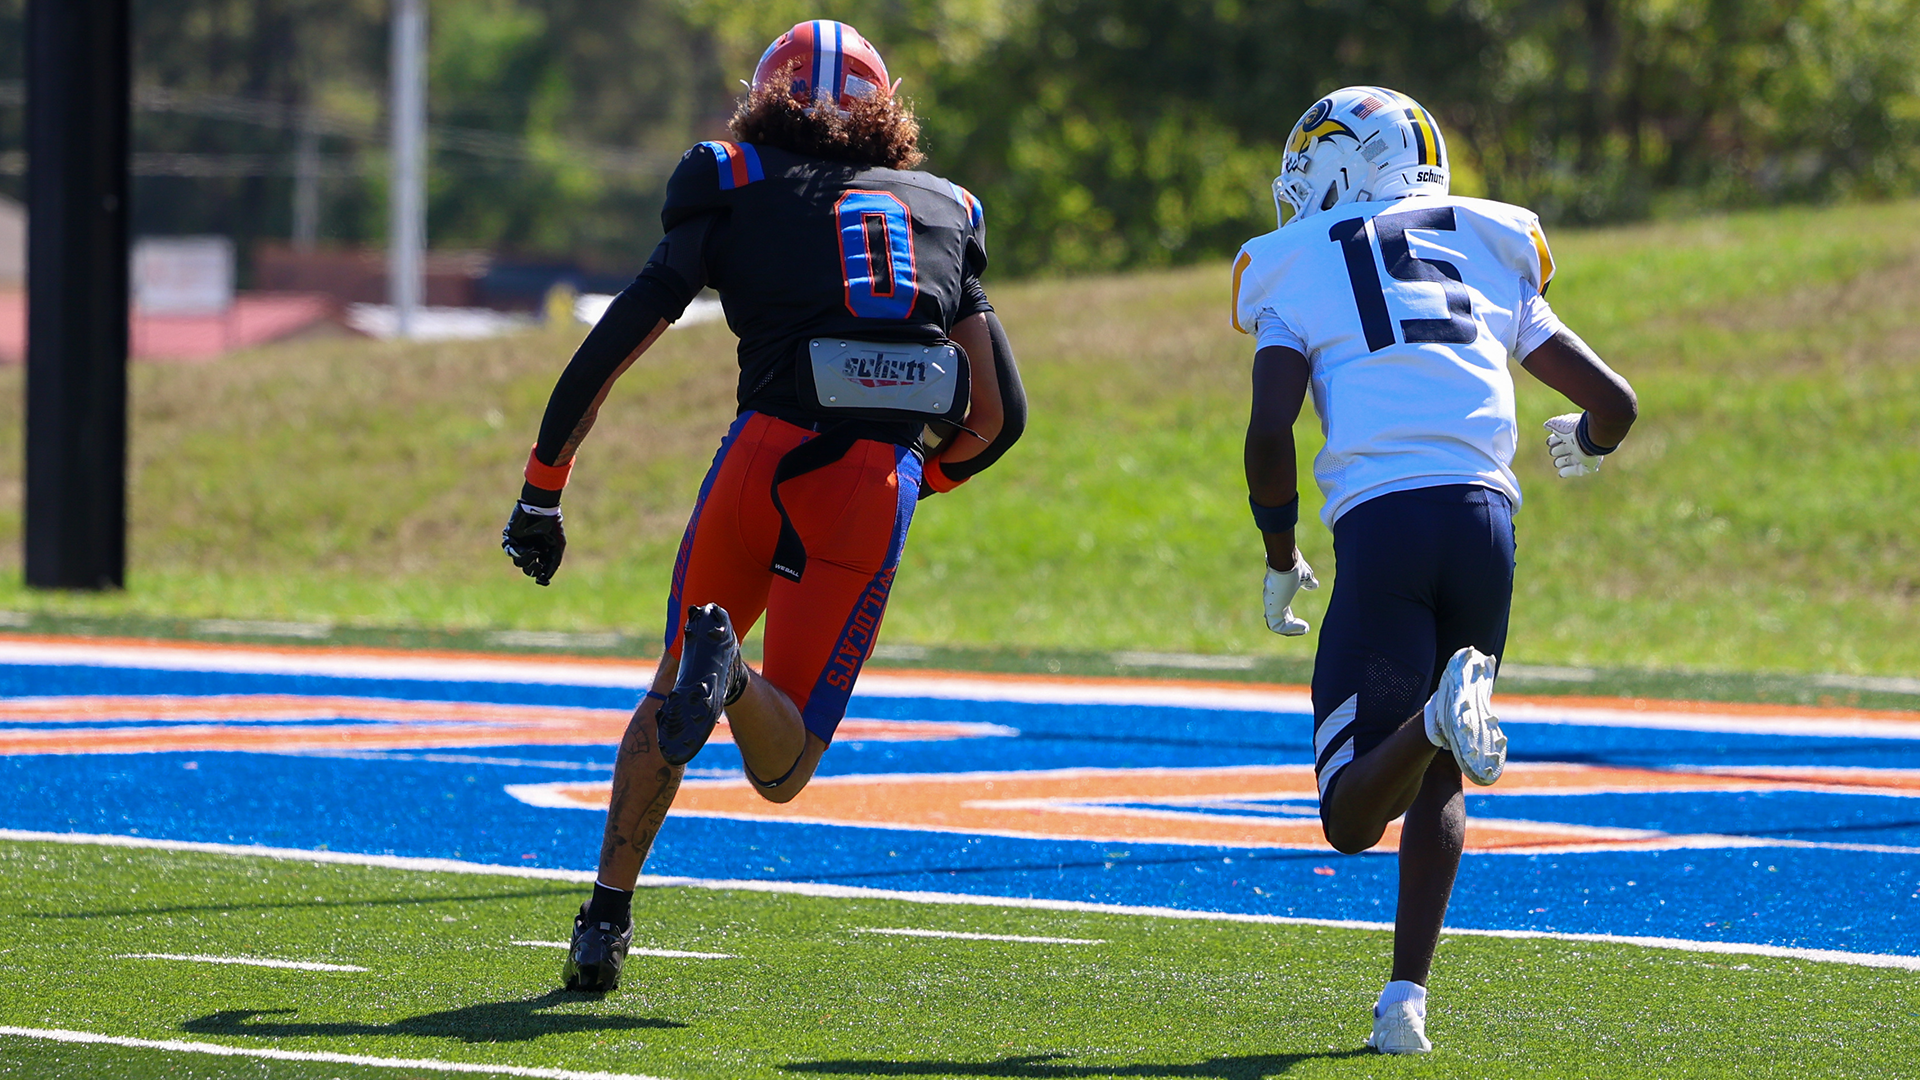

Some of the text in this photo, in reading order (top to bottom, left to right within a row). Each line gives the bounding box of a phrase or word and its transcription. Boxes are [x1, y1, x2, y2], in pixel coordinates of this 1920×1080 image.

[1416, 169, 1445, 186] schutt
[833, 189, 919, 319] 0
[1328, 206, 1478, 353] 15
[843, 353, 927, 382] schutt
[826, 567, 898, 691] WILDCATS
